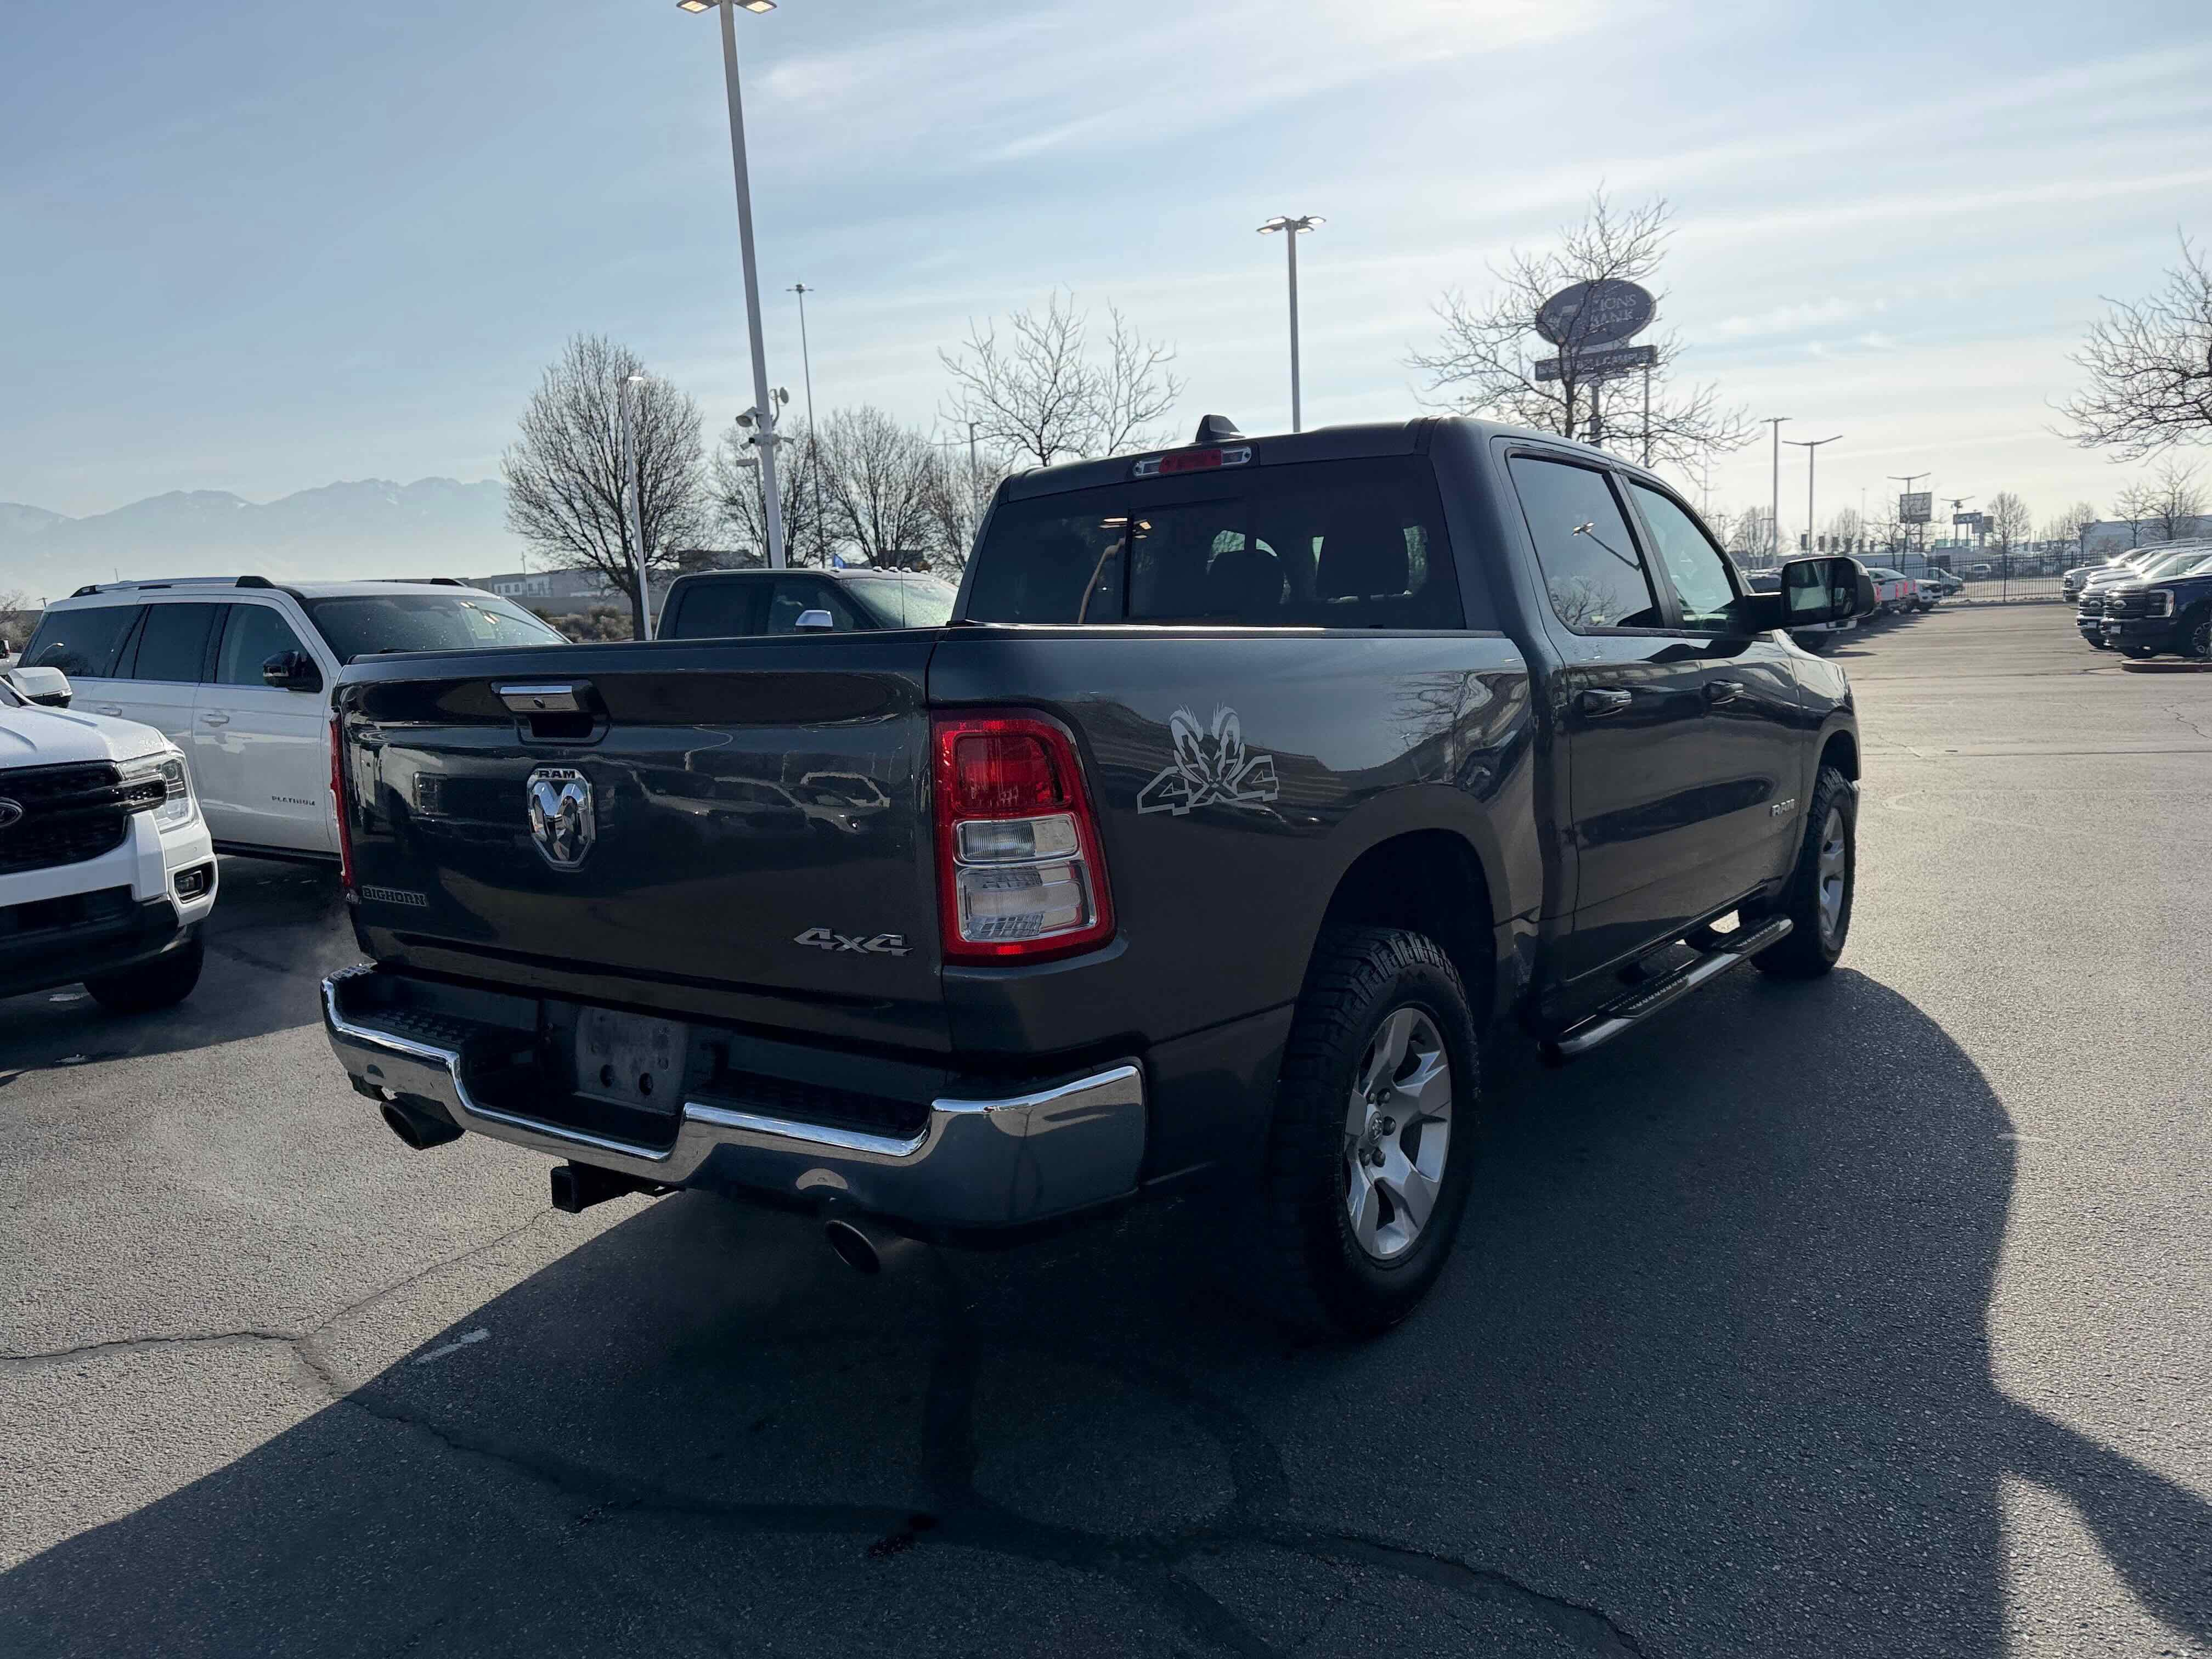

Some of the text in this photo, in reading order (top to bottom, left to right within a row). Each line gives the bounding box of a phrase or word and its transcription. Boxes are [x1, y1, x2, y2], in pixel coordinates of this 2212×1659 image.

[538, 769, 575, 779] RAM
[272, 795, 316, 806] PLATINUM
[361, 885, 428, 907] BIGHORN
